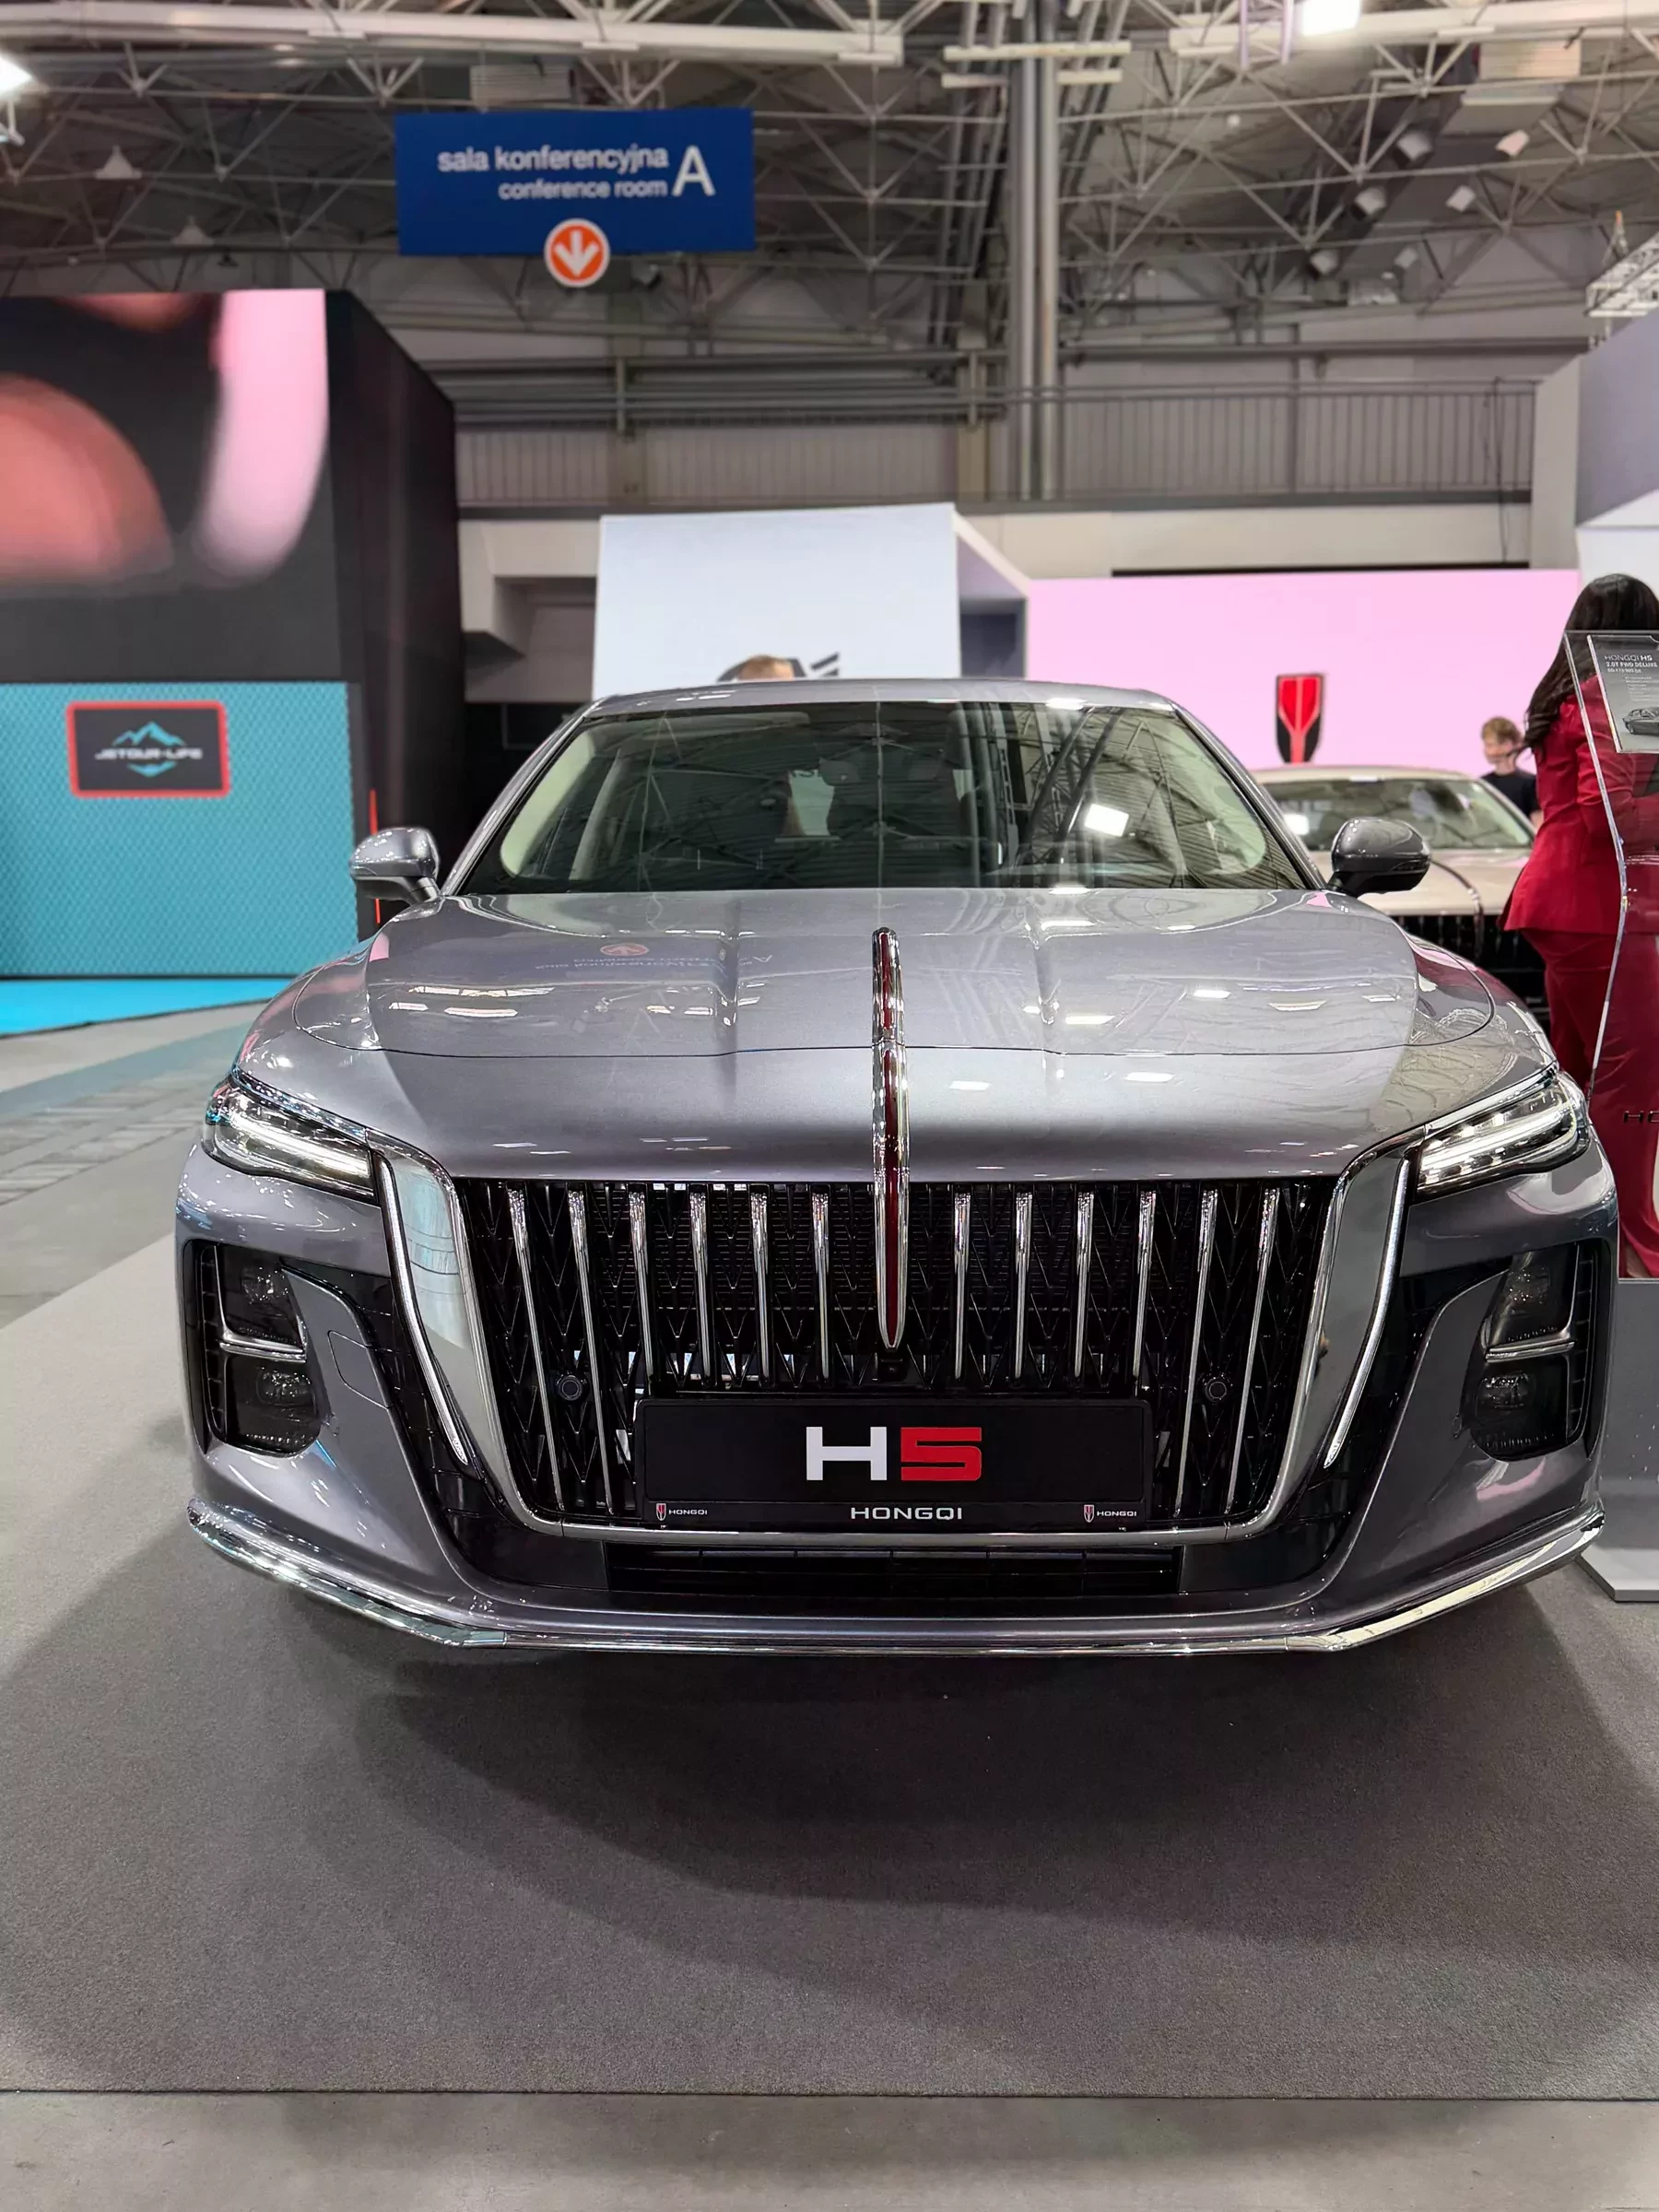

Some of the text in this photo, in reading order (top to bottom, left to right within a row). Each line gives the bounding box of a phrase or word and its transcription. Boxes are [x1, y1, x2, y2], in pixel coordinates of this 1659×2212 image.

[437, 143, 670, 175] sala konferencyjna
[672, 145, 716, 197] A
[498, 178, 668, 200] conference room
[806, 1426, 982, 1481] H5
[850, 1506, 963, 1521] HONGQI
